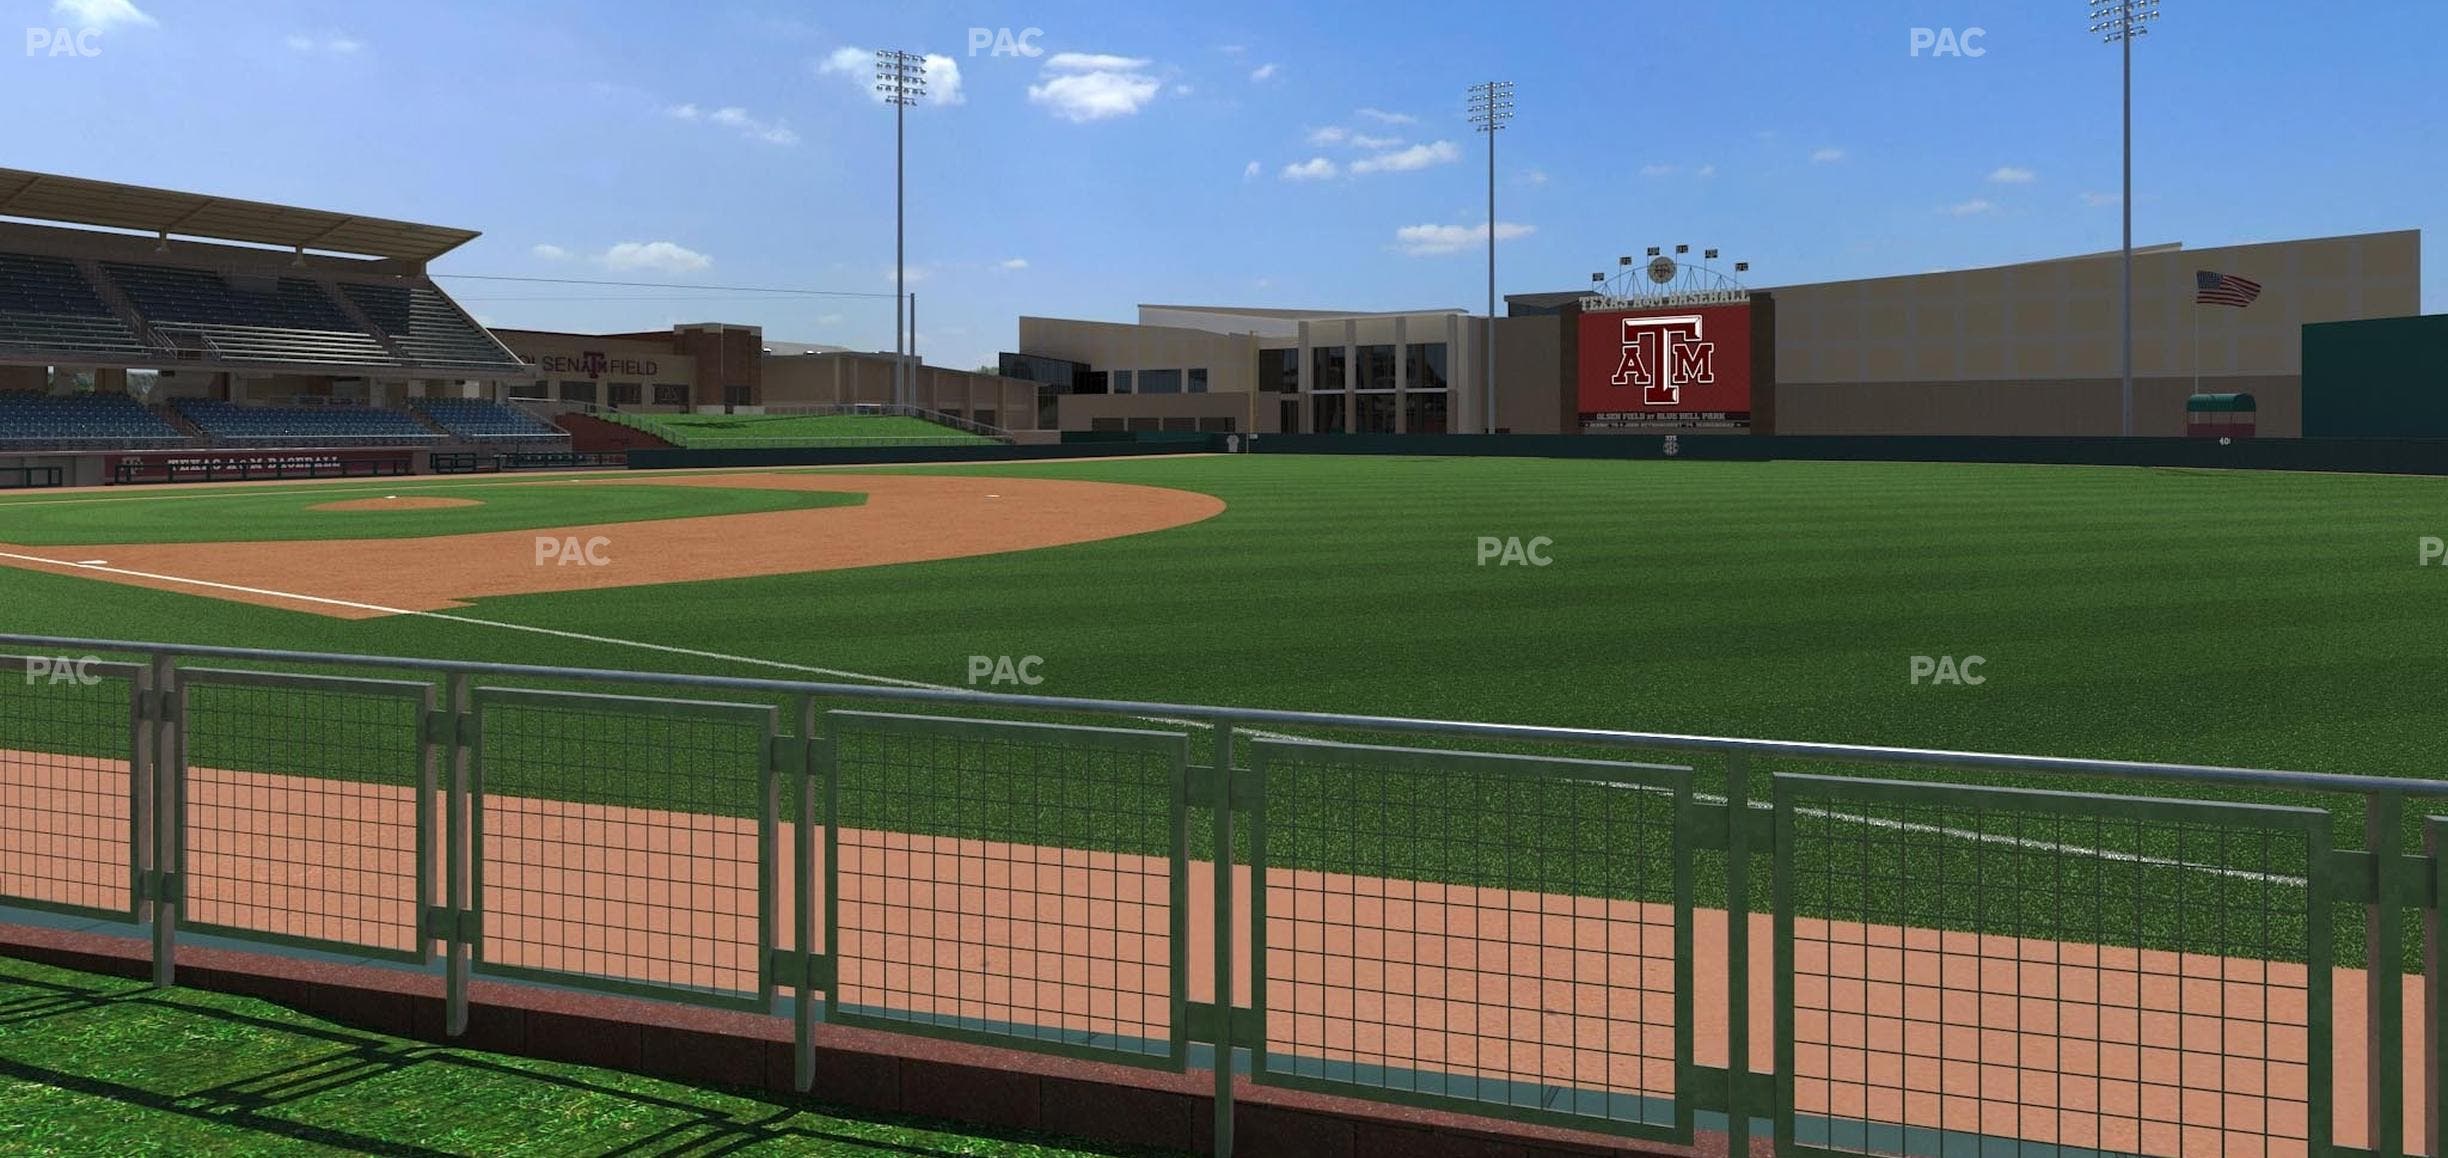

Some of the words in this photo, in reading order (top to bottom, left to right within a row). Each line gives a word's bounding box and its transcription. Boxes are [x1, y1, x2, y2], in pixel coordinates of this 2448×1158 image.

[1579, 294, 1629, 311] TEXAS
[1670, 289, 1750, 306] BASEBALL
[610, 359, 658, 376] FIELD
